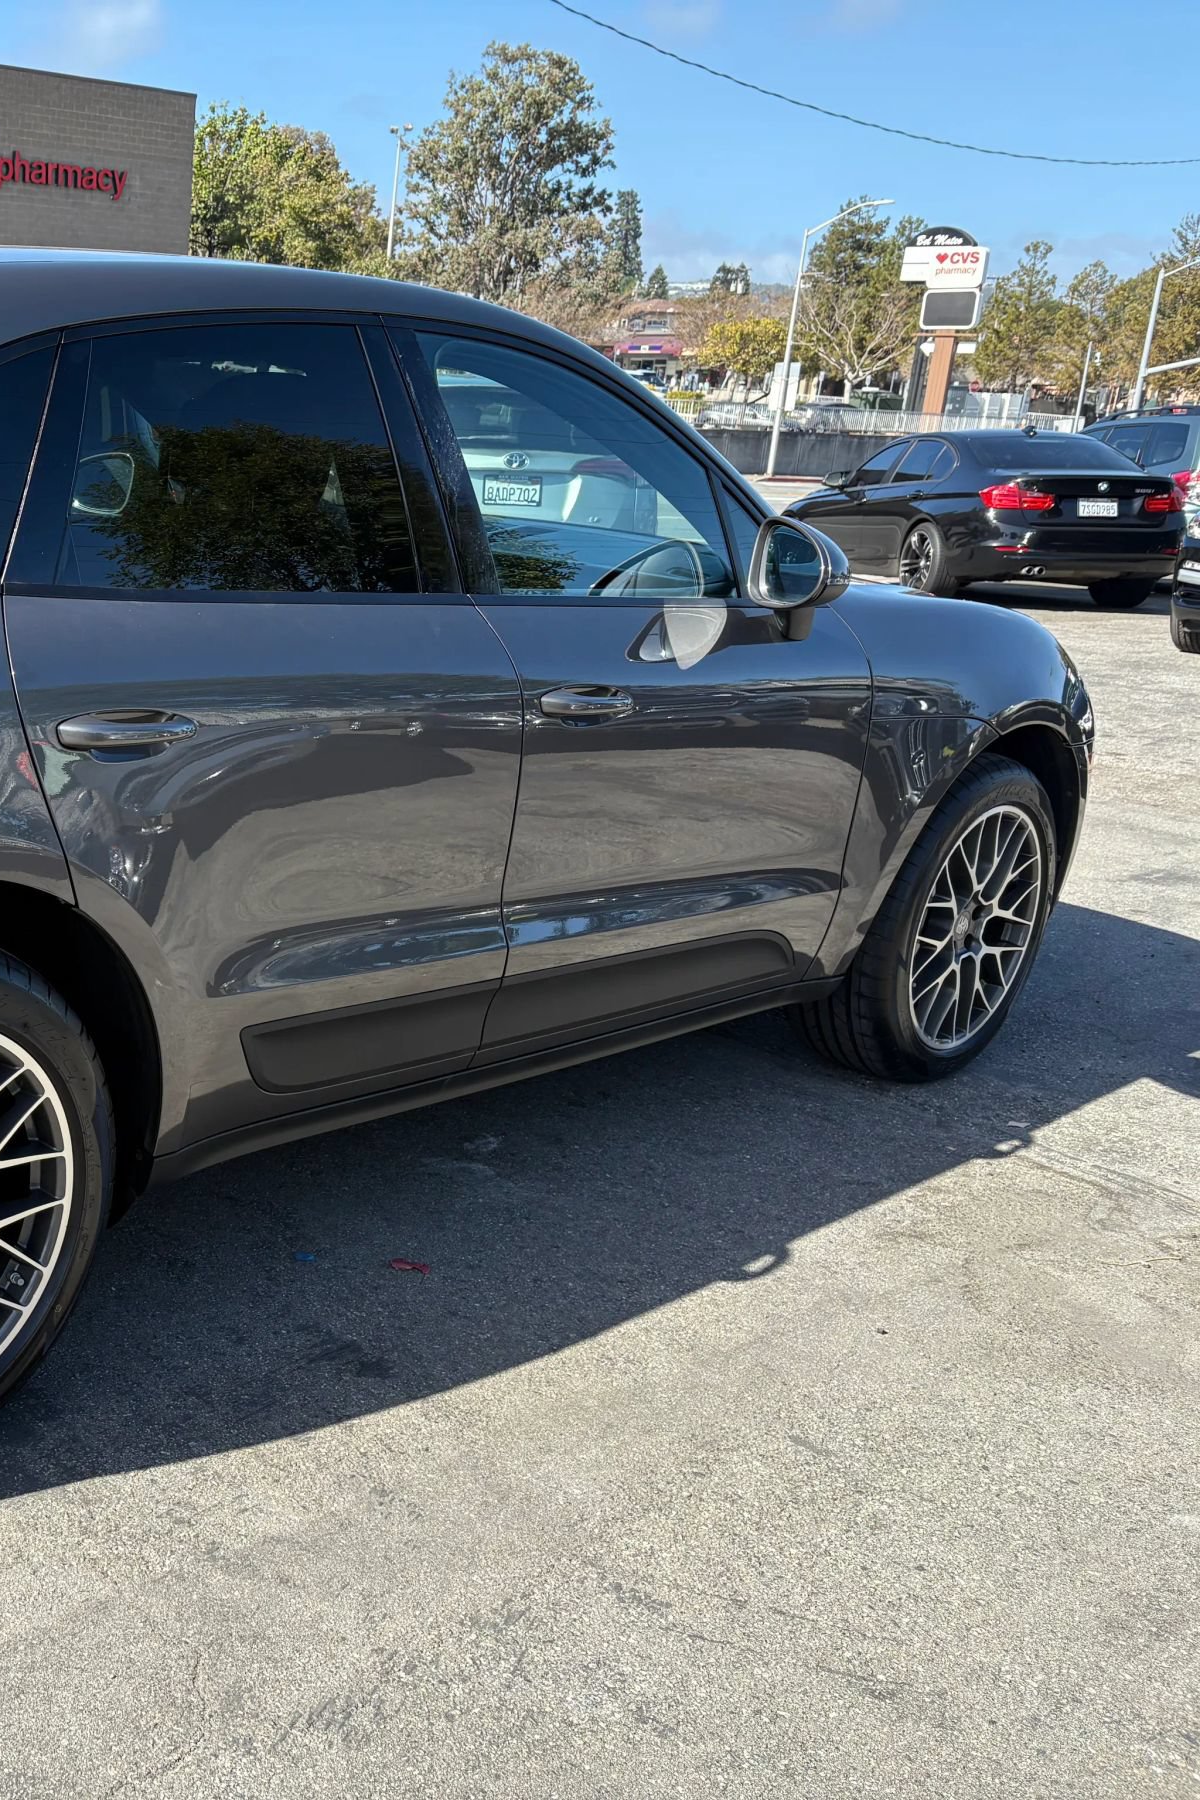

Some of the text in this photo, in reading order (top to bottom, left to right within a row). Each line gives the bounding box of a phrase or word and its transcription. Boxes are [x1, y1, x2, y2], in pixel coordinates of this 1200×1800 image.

[934, 233, 964, 246] Mateo
[950, 251, 980, 264] CVS
[935, 266, 977, 276] pharmacy
[487, 486, 537, 502] 8ADP702
